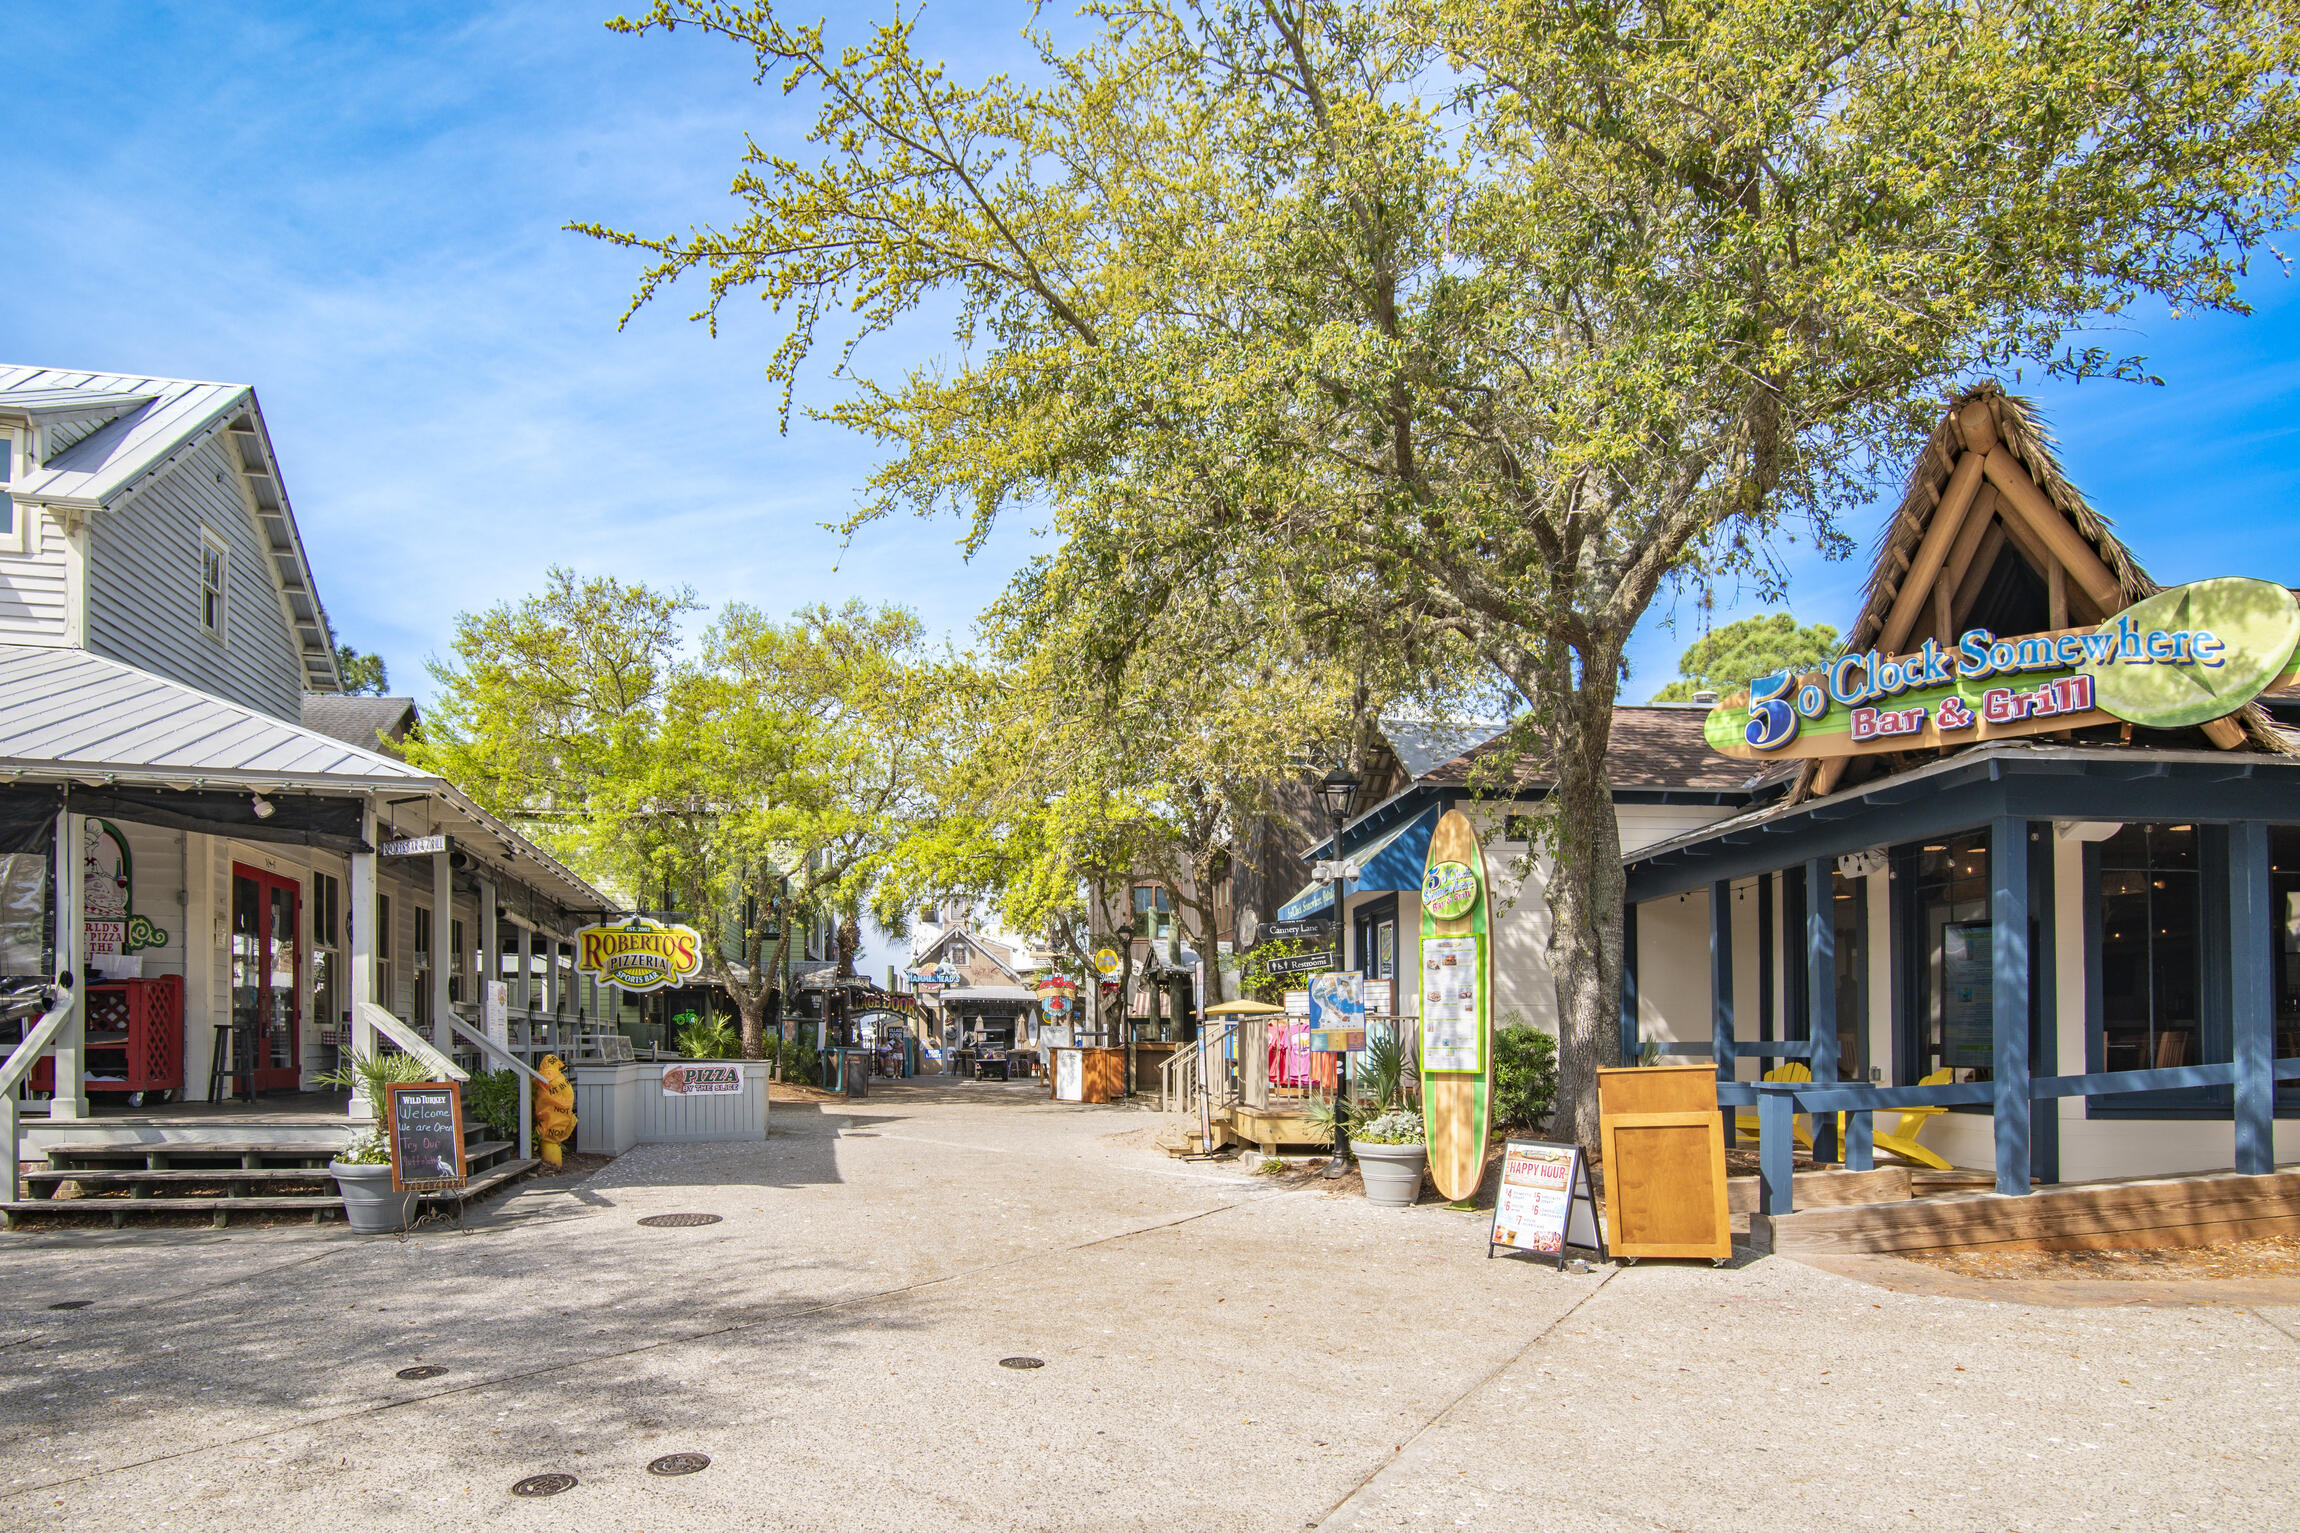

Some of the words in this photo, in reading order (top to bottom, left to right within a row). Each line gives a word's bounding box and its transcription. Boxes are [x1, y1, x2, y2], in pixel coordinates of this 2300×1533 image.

[1745, 670, 1798, 749] 5
[1798, 637, 1954, 717] o'Clock
[1958, 615, 2223, 679] Somewhere
[1851, 707, 1928, 741] Bar
[1936, 696, 1974, 730] &
[1983, 674, 2095, 723] Grill
[1428, 867, 1441, 890] 5
[1423, 880, 1473, 905] Somewhere
[1432, 901, 1445, 912] Bar
[1446, 895, 1453, 904] &
[1454, 891, 1471, 902] Grill
[85, 923, 119, 932] RLD'S
[1269, 926, 1299, 935] Cannery
[1300, 924, 1319, 932] Lane
[90, 933, 122, 942] PIZZA
[90, 943, 114, 951] THE
[583, 933, 695, 969] ROBERTO'S
[610, 954, 667, 970] PIZZERIA
[1291, 959, 1327, 969] Restrooms
[616, 971, 643, 983] SPORTS
[644, 971, 659, 982] BAR
[882, 997, 917, 1018] DOOR
[684, 1067, 739, 1084] PIZZA
[682, 1084, 694, 1092] BY
[402, 1096, 421, 1104] WILD
[421, 1095, 446, 1104] TURKEY
[400, 1105, 450, 1119] Welcome
[553, 1105, 569, 1114] NOT
[433, 1122, 454, 1132] Open
[400, 1137, 417, 1152] Try
[423, 1137, 440, 1149] Our
[1509, 1161, 1539, 1176] HAPPY
[1540, 1164, 1566, 1179] HOUR
